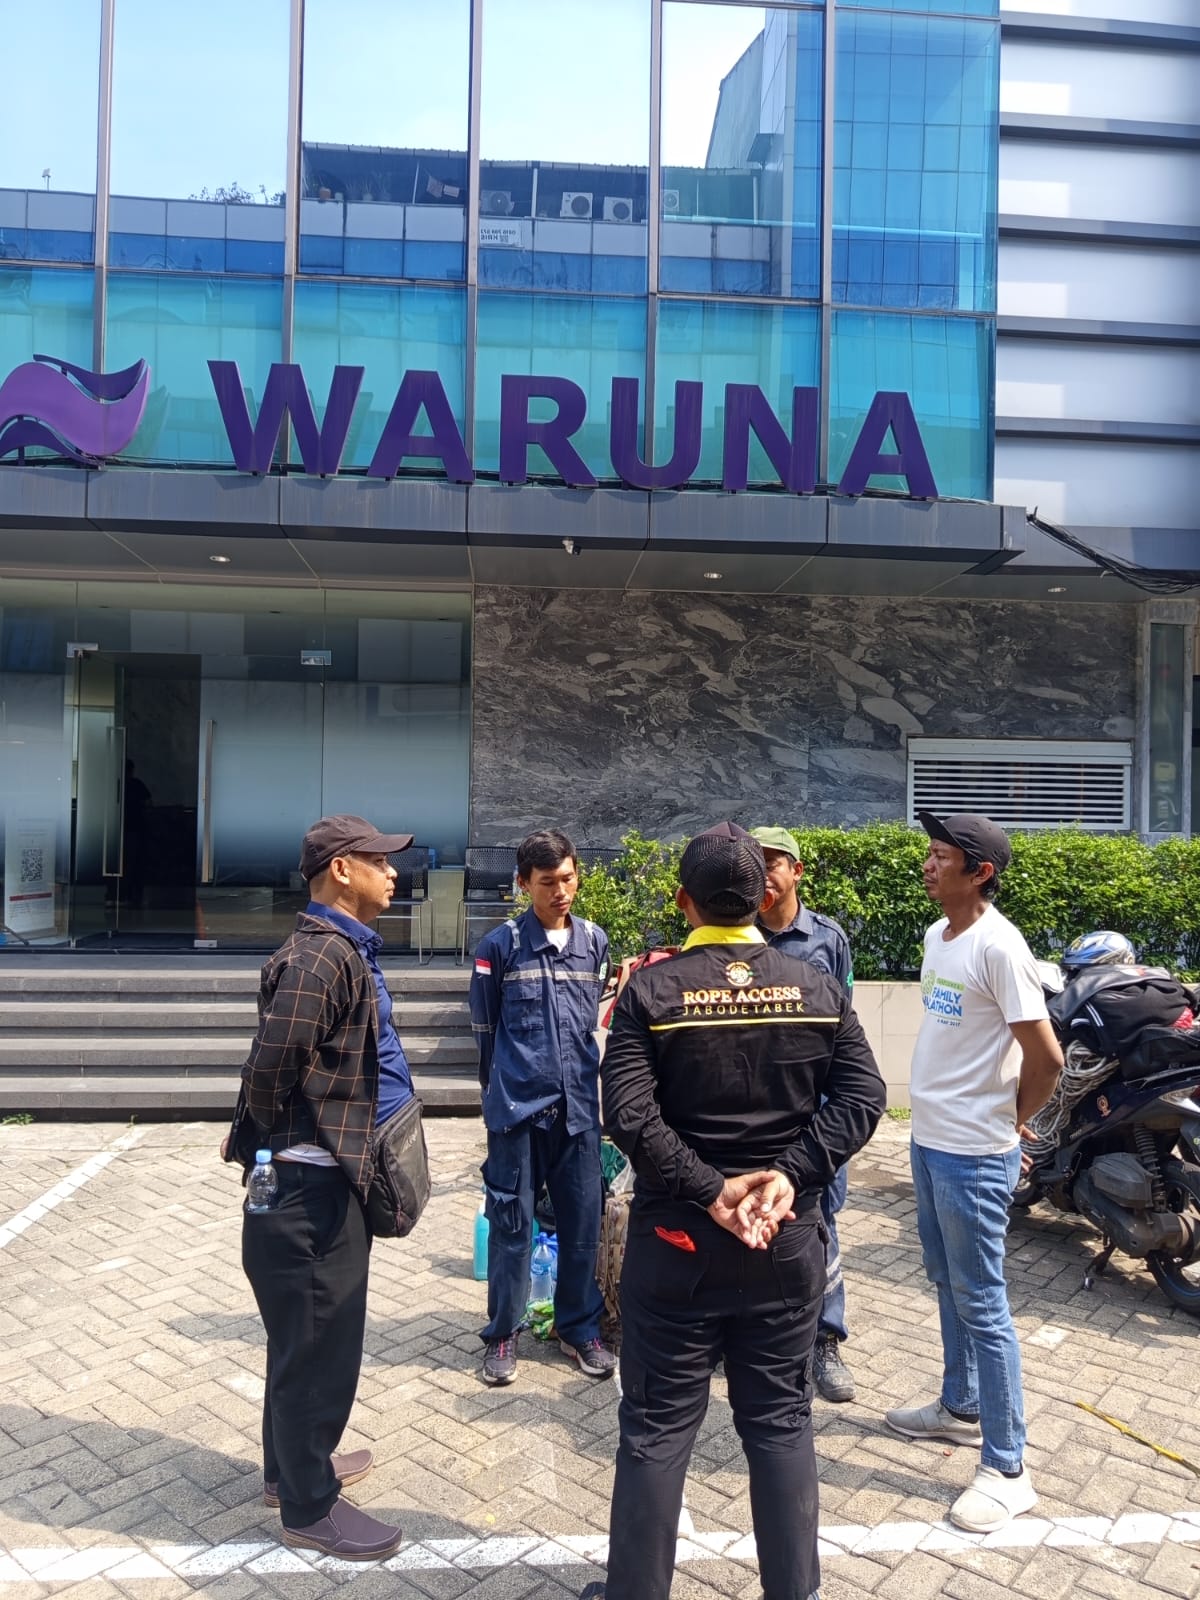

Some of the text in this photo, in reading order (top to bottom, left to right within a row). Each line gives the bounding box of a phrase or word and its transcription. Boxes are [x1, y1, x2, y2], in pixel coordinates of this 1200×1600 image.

[207, 360, 937, 498] WARUNA
[683, 986, 801, 1005] ROPE ACCESS
[932, 986, 962, 1005] FAMILY
[682, 1002, 805, 1016] JABODETABEK
